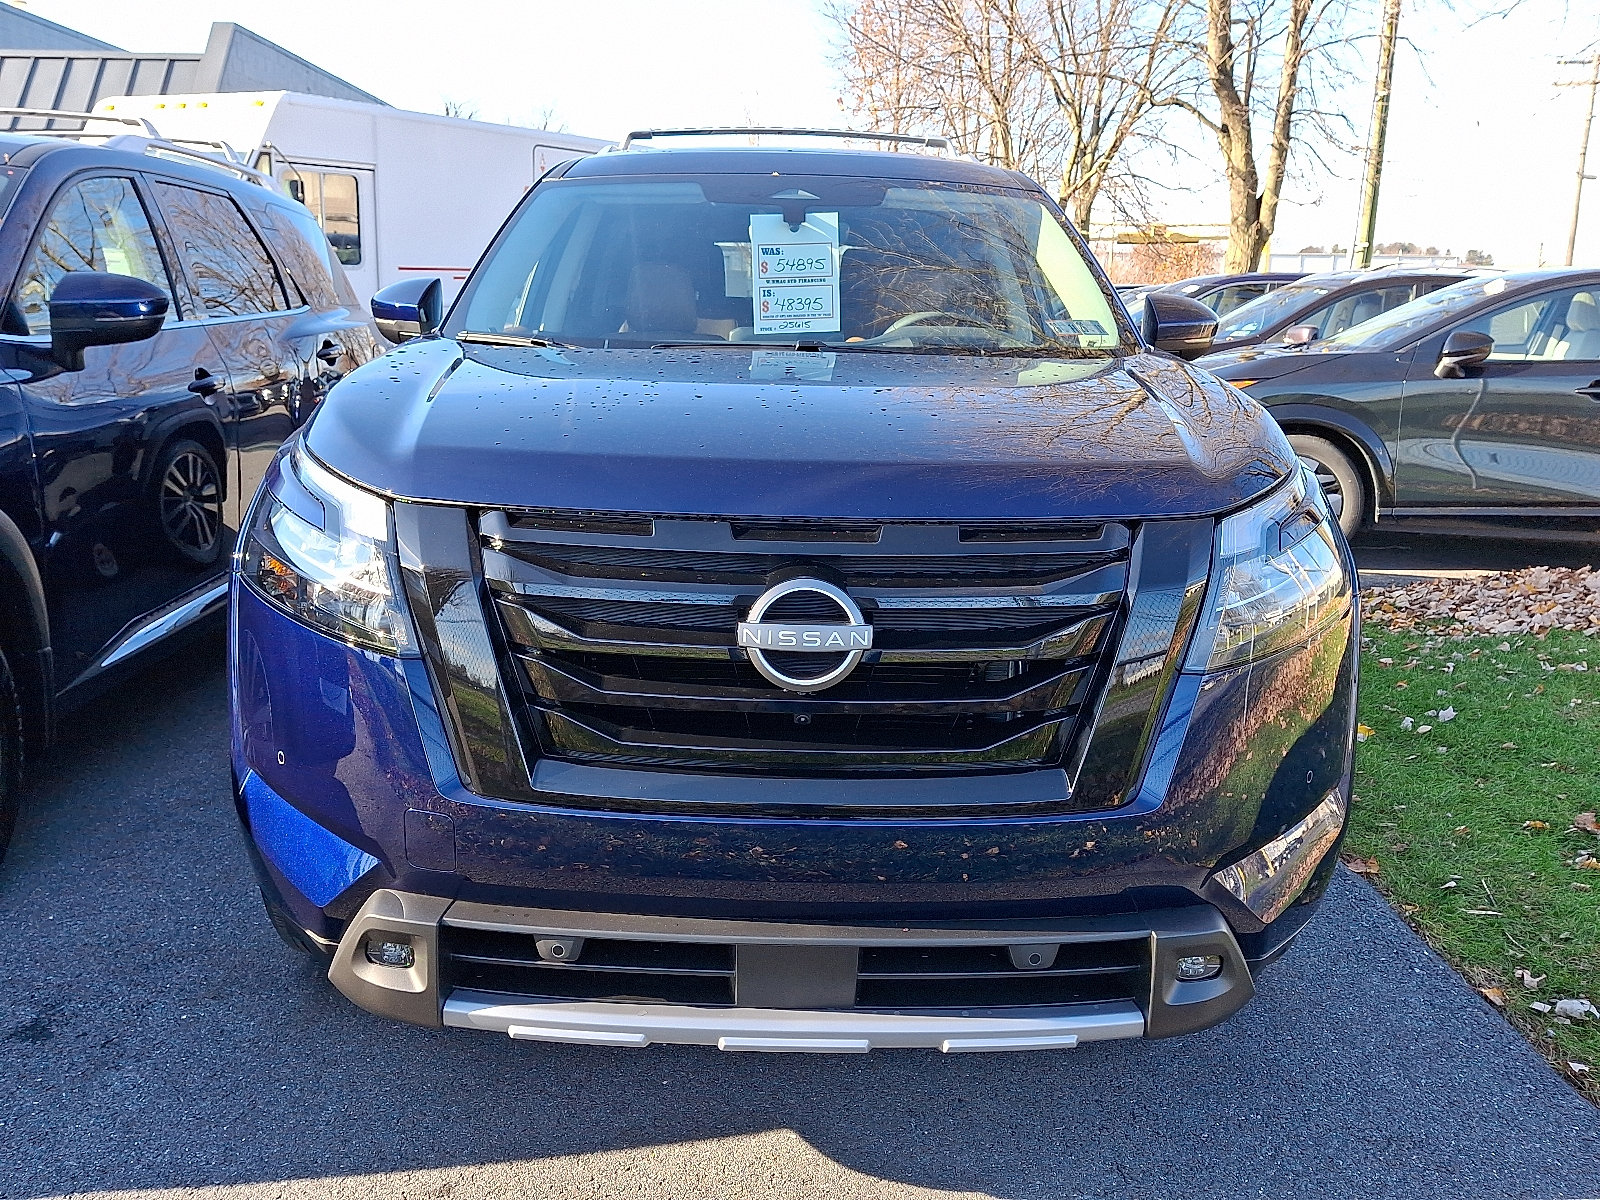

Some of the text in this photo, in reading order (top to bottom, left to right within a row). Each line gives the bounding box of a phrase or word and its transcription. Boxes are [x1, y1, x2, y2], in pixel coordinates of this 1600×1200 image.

[760, 247, 784, 256] WAS:
[760, 258, 826, 274] $ 54895
[762, 289, 775, 297] IS:
[762, 297, 823, 313] $ 48395
[742, 628, 868, 647] NISSAN
